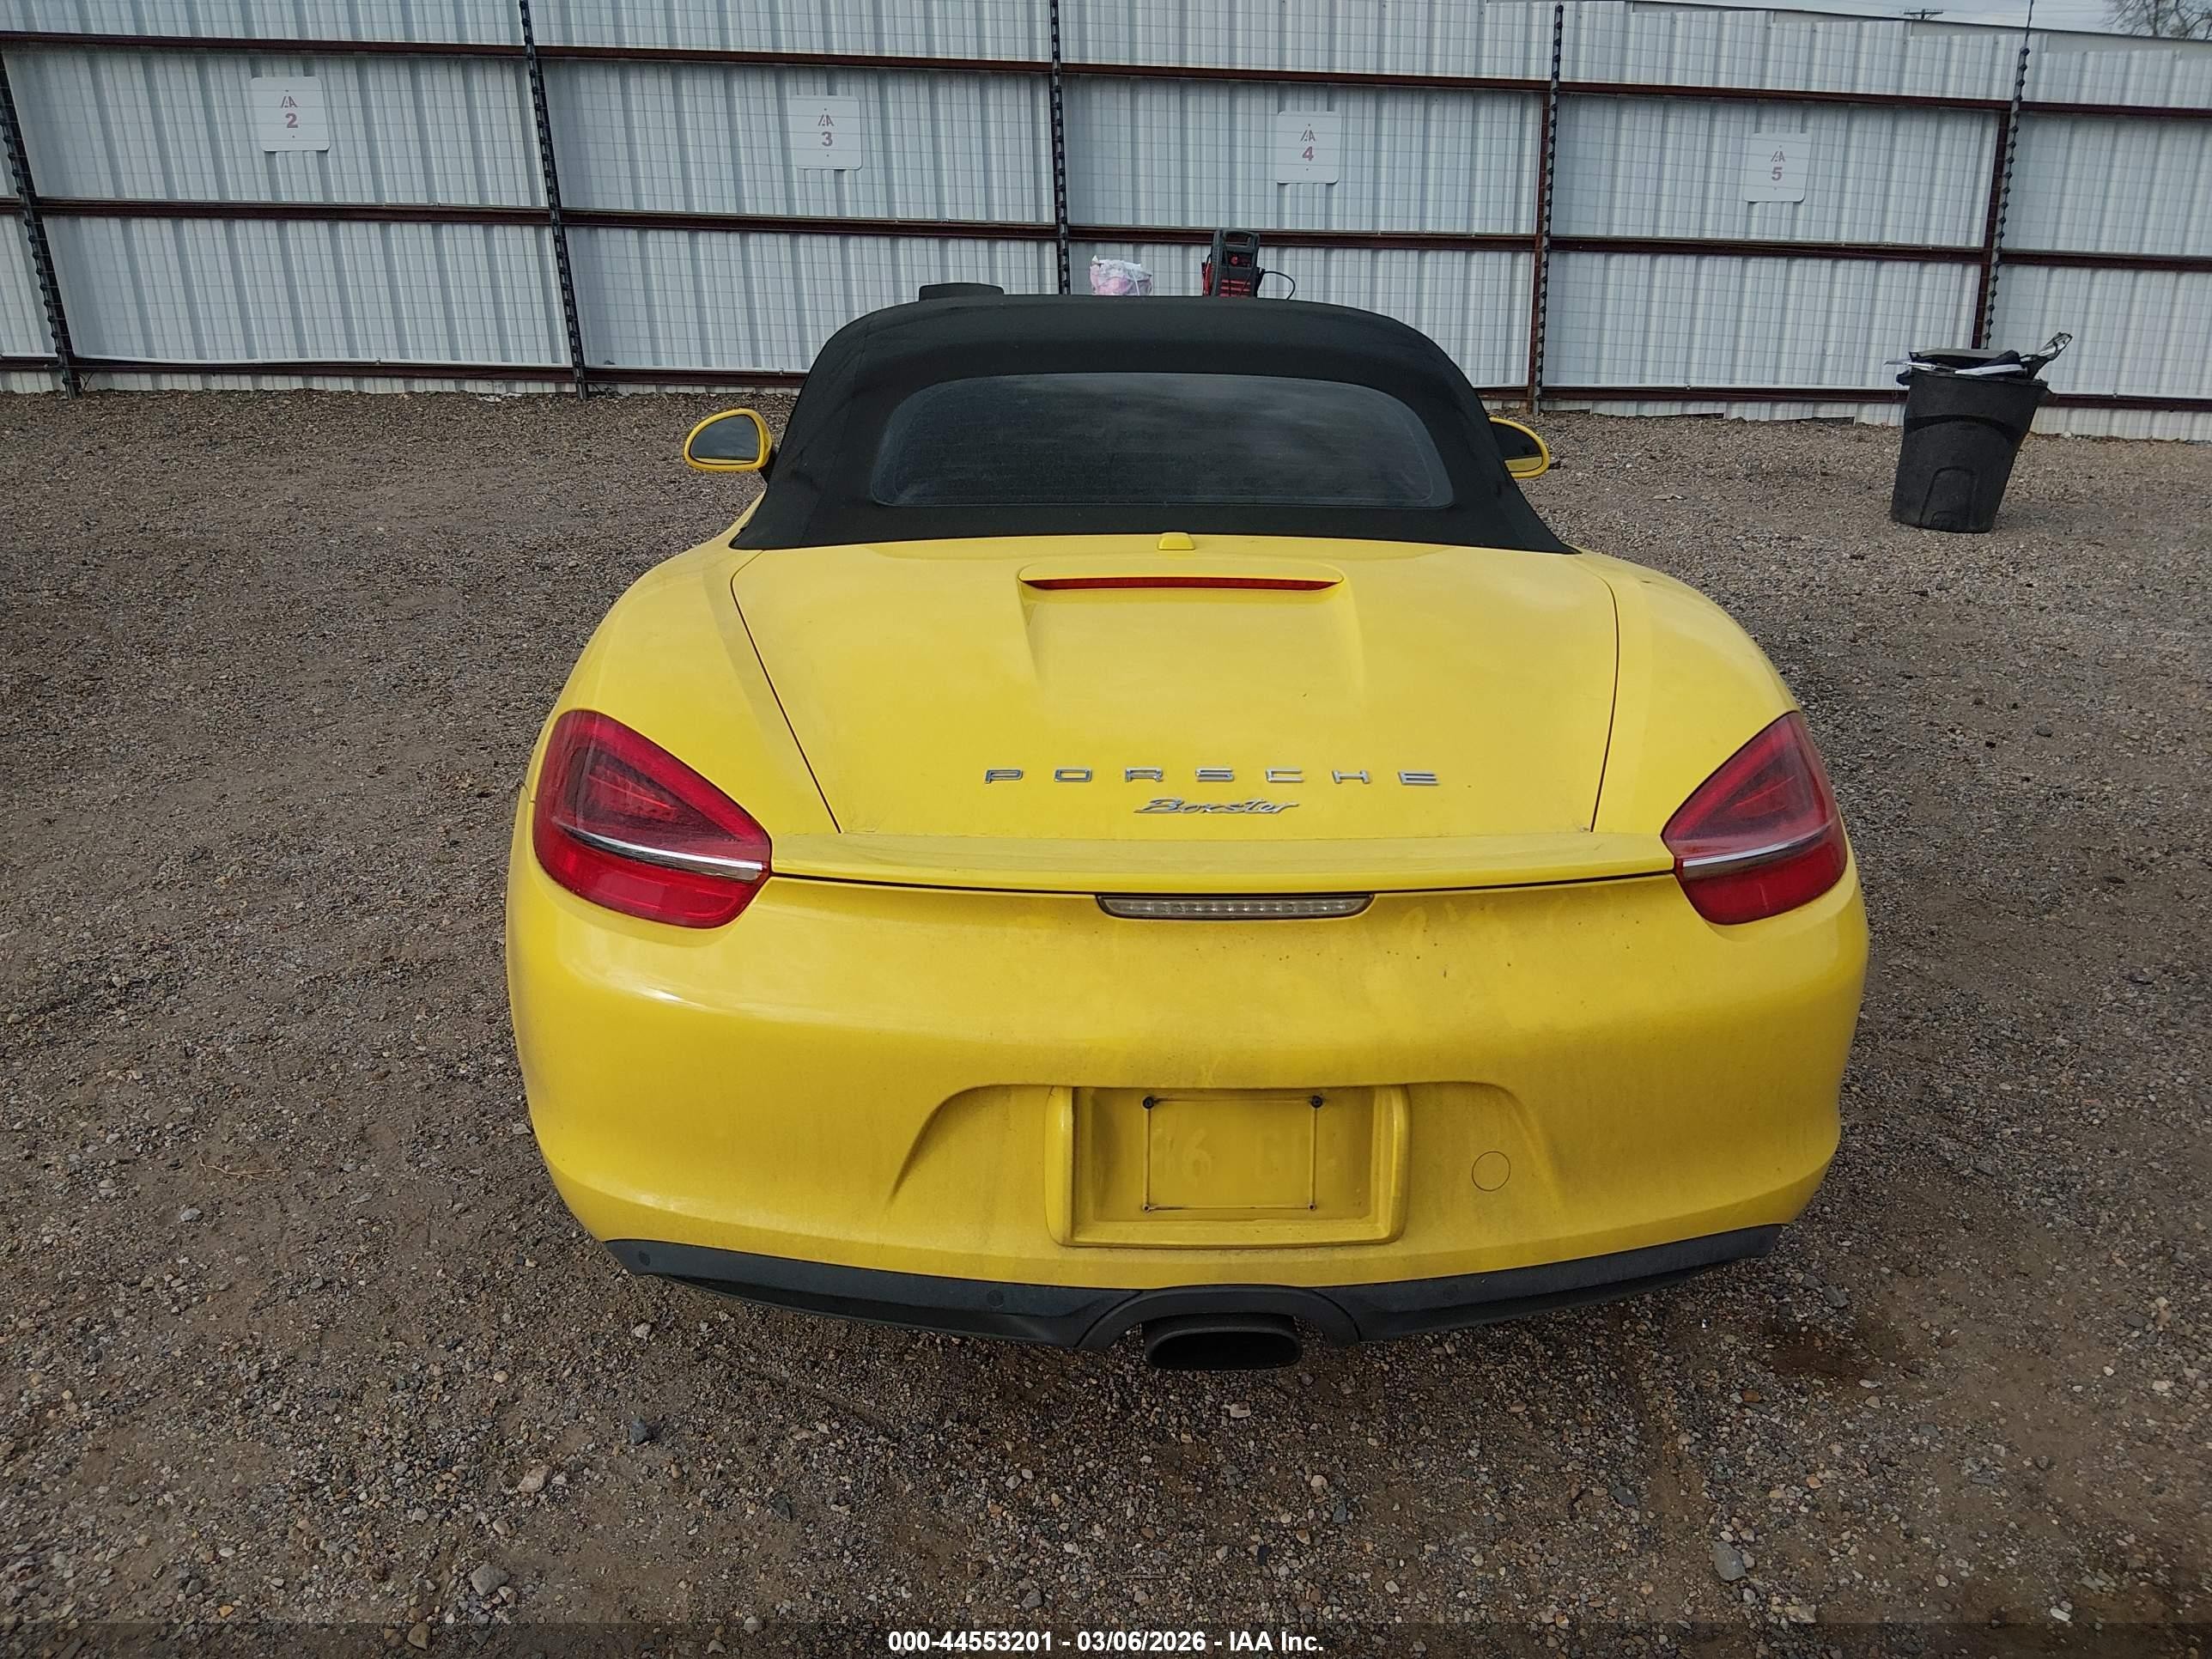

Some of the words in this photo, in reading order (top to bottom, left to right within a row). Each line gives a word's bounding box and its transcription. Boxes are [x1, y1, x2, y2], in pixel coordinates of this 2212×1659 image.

[285, 112, 299, 129] 2
[821, 131, 833, 147] 3
[1302, 146, 1315, 161] 4
[1771, 167, 1783, 181] 5
[985, 767, 1439, 787] PORSCHE
[1133, 797, 1301, 815] Boxster
